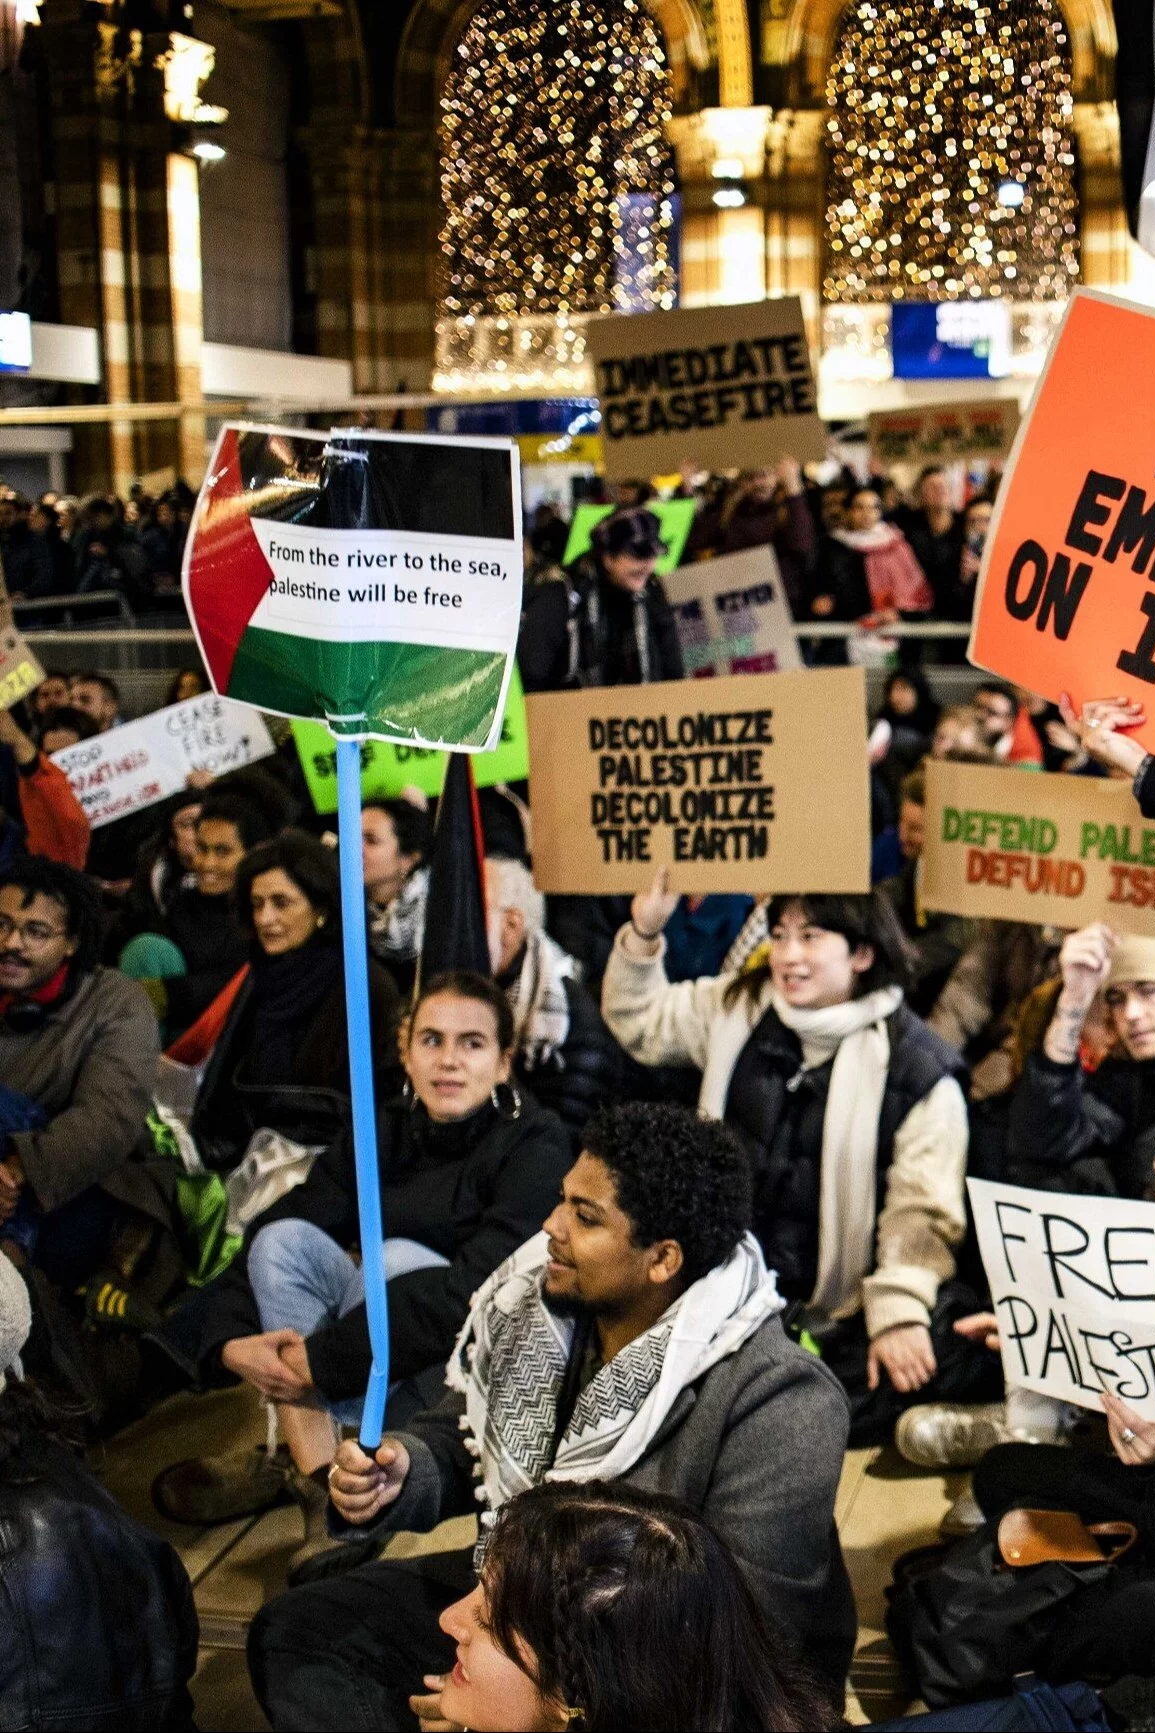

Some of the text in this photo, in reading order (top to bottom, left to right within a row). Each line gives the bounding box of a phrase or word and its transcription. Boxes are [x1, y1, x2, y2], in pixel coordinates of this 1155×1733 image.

[602, 334, 807, 396] IMMEDIATE
[604, 378, 815, 438] CEASEFIRE
[269, 540, 508, 581] From the river to the sea,
[269, 577, 463, 608] palestine will be free
[1005, 539, 1092, 642] ON
[588, 709, 773, 750] DECOLONIZE
[599, 749, 763, 787] PALESTINE
[590, 786, 775, 825] DECOLONIZE
[596, 825, 769, 863] THE EARTH
[941, 806, 1058, 855] DEFEND
[966, 849, 1086, 898] DEFUND
